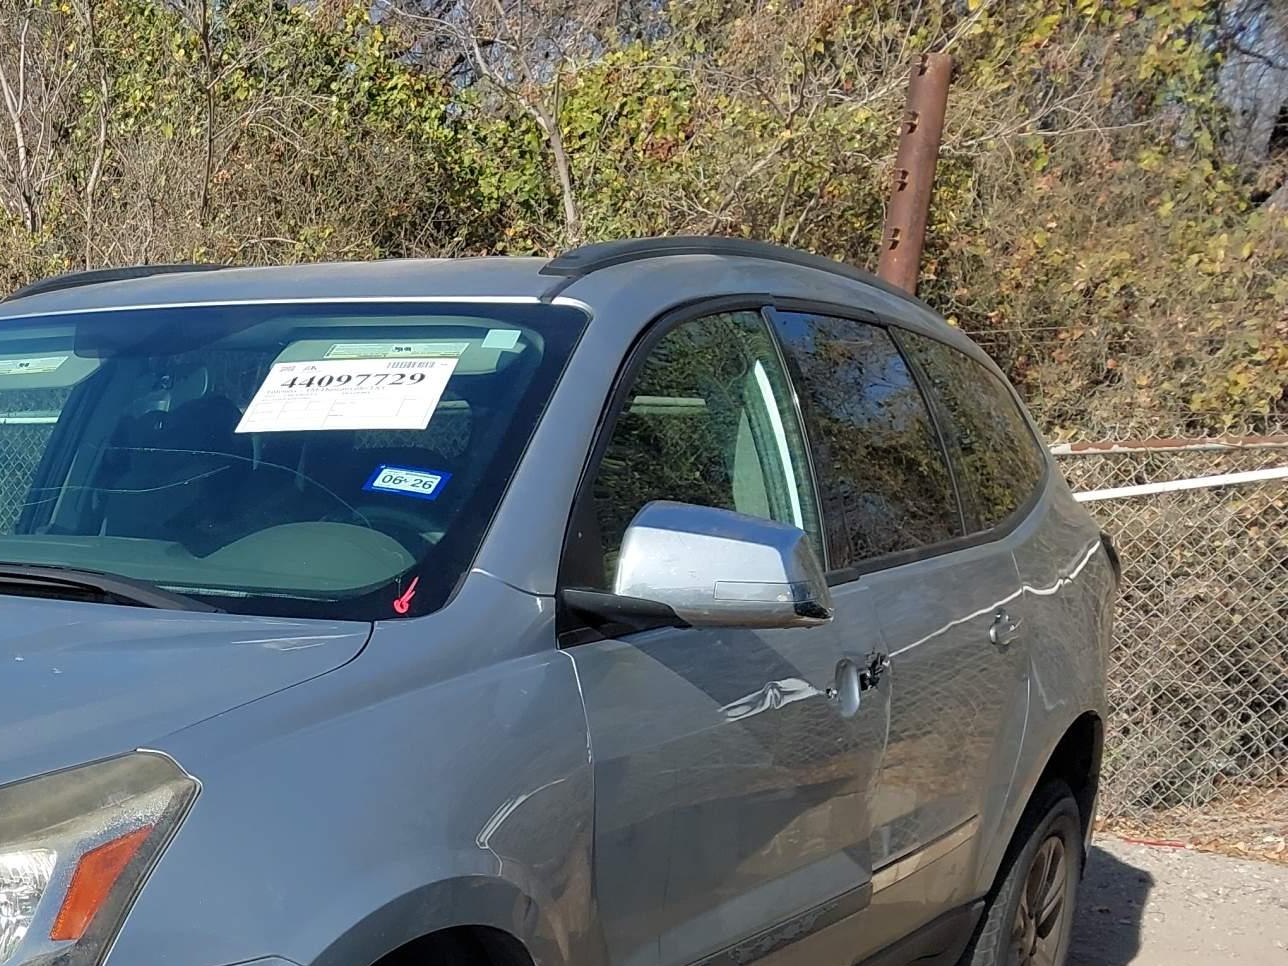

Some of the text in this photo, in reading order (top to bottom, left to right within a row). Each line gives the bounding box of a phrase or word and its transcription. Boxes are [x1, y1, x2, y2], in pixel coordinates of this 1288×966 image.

[280, 371, 427, 389] 44097729
[381, 473, 434, 490] 06 26
